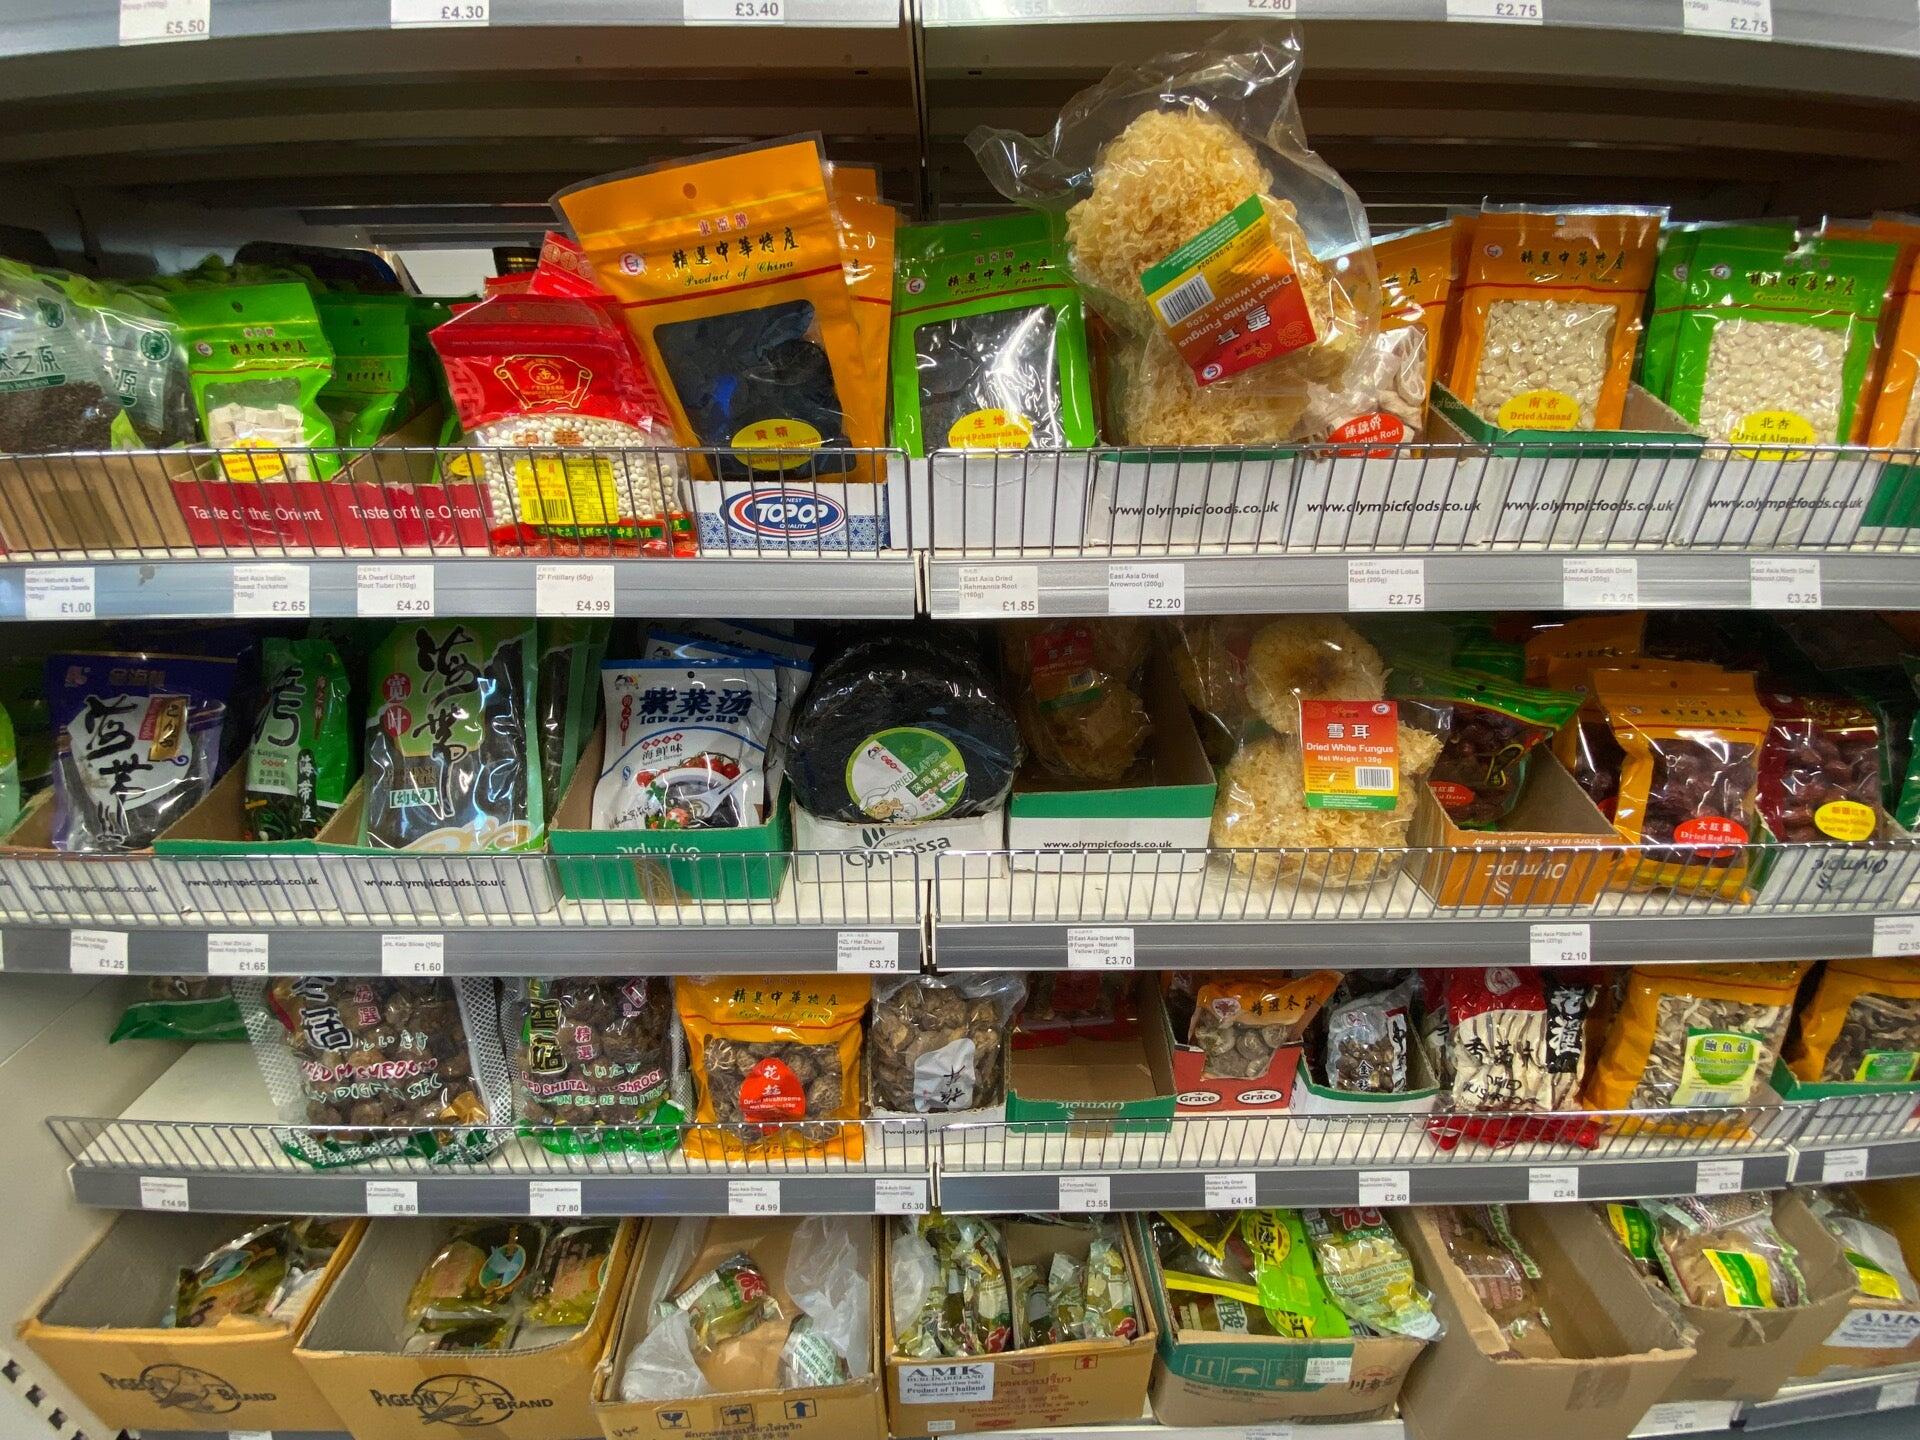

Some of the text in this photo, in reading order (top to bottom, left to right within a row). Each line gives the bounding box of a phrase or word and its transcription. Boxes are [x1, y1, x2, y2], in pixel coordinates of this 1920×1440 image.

[441, 5, 485, 20] £4.30
[735, 2, 779, 17] £3.40
[1496, 3, 1538, 18] £2.75
[166, 19, 206, 34] £5.50
[1730, 18, 1769, 34] £2.75
[684, 260, 793, 287] Product of China
[1250, 273, 1271, 289] Net
[1178, 274, 1293, 348] Dried White Fungus
[1510, 412, 1572, 421] Dried Almond
[1760, 418, 1789, 430] 北杏
[1380, 427, 1400, 439] Root
[1736, 433, 1808, 444] Dried Almond
[951, 435, 971, 443] Dried
[247, 509, 272, 520] the
[392, 505, 408, 519] of
[576, 574, 594, 582] (50g)
[1366, 576, 1387, 584] (200g)
[1143, 581, 1164, 589] (200g)
[1148, 598, 1181, 609] £2.20
[1388, 594, 1422, 605] £2.75
[1787, 593, 1818, 604] £3.25
[61, 602, 92, 614] £1.00
[272, 601, 306, 612] £2.65
[397, 600, 430, 611] £4.20
[576, 600, 611, 611] £4.99
[1002, 600, 1035, 612] £1.85
[636, 687, 754, 717] 紫菜汤
[695, 714, 739, 725] soup
[1326, 722, 1371, 740] 雪耳
[1306, 742, 1394, 756] Dried White Fungus
[1317, 754, 1331, 762] Net
[1332, 755, 1362, 764] Weight:
[890, 771, 914, 793] DRIED
[1529, 837, 1550, 845] cool
[1573, 837, 1601, 845] Store
[1680, 830, 1723, 842] Dried Red
[1043, 840, 1172, 849] www.olympicfoods.co.uk
[1472, 838, 1499, 846] away
[1501, 838, 1528, 847] place
[1105, 956, 1132, 966] £3.70
[1560, 952, 1587, 961] £2.10
[99, 958, 125, 969] £1.25
[239, 961, 266, 971] £1.65
[414, 962, 441, 972] £1.60
[869, 960, 896, 969] £3.75
[1180, 1094, 1216, 1103] Grace
[1241, 1093, 1277, 1101] Grace
[1384, 1194, 1407, 1202] £2.60
[1553, 1190, 1576, 1198] £2.45
[901, 1202, 924, 1210] £5.30
[1085, 1200, 1108, 1208] £3.55
[1231, 1196, 1254, 1205] £4.15
[755, 1203, 778, 1211] £4.99
[800, 1339, 812, 1353] NET
[909, 1364, 984, 1378] AMK
[951, 1385, 986, 1393] Thailand
[369, 1389, 438, 1407] PIGEON
[491, 1397, 554, 1411] BRAND
